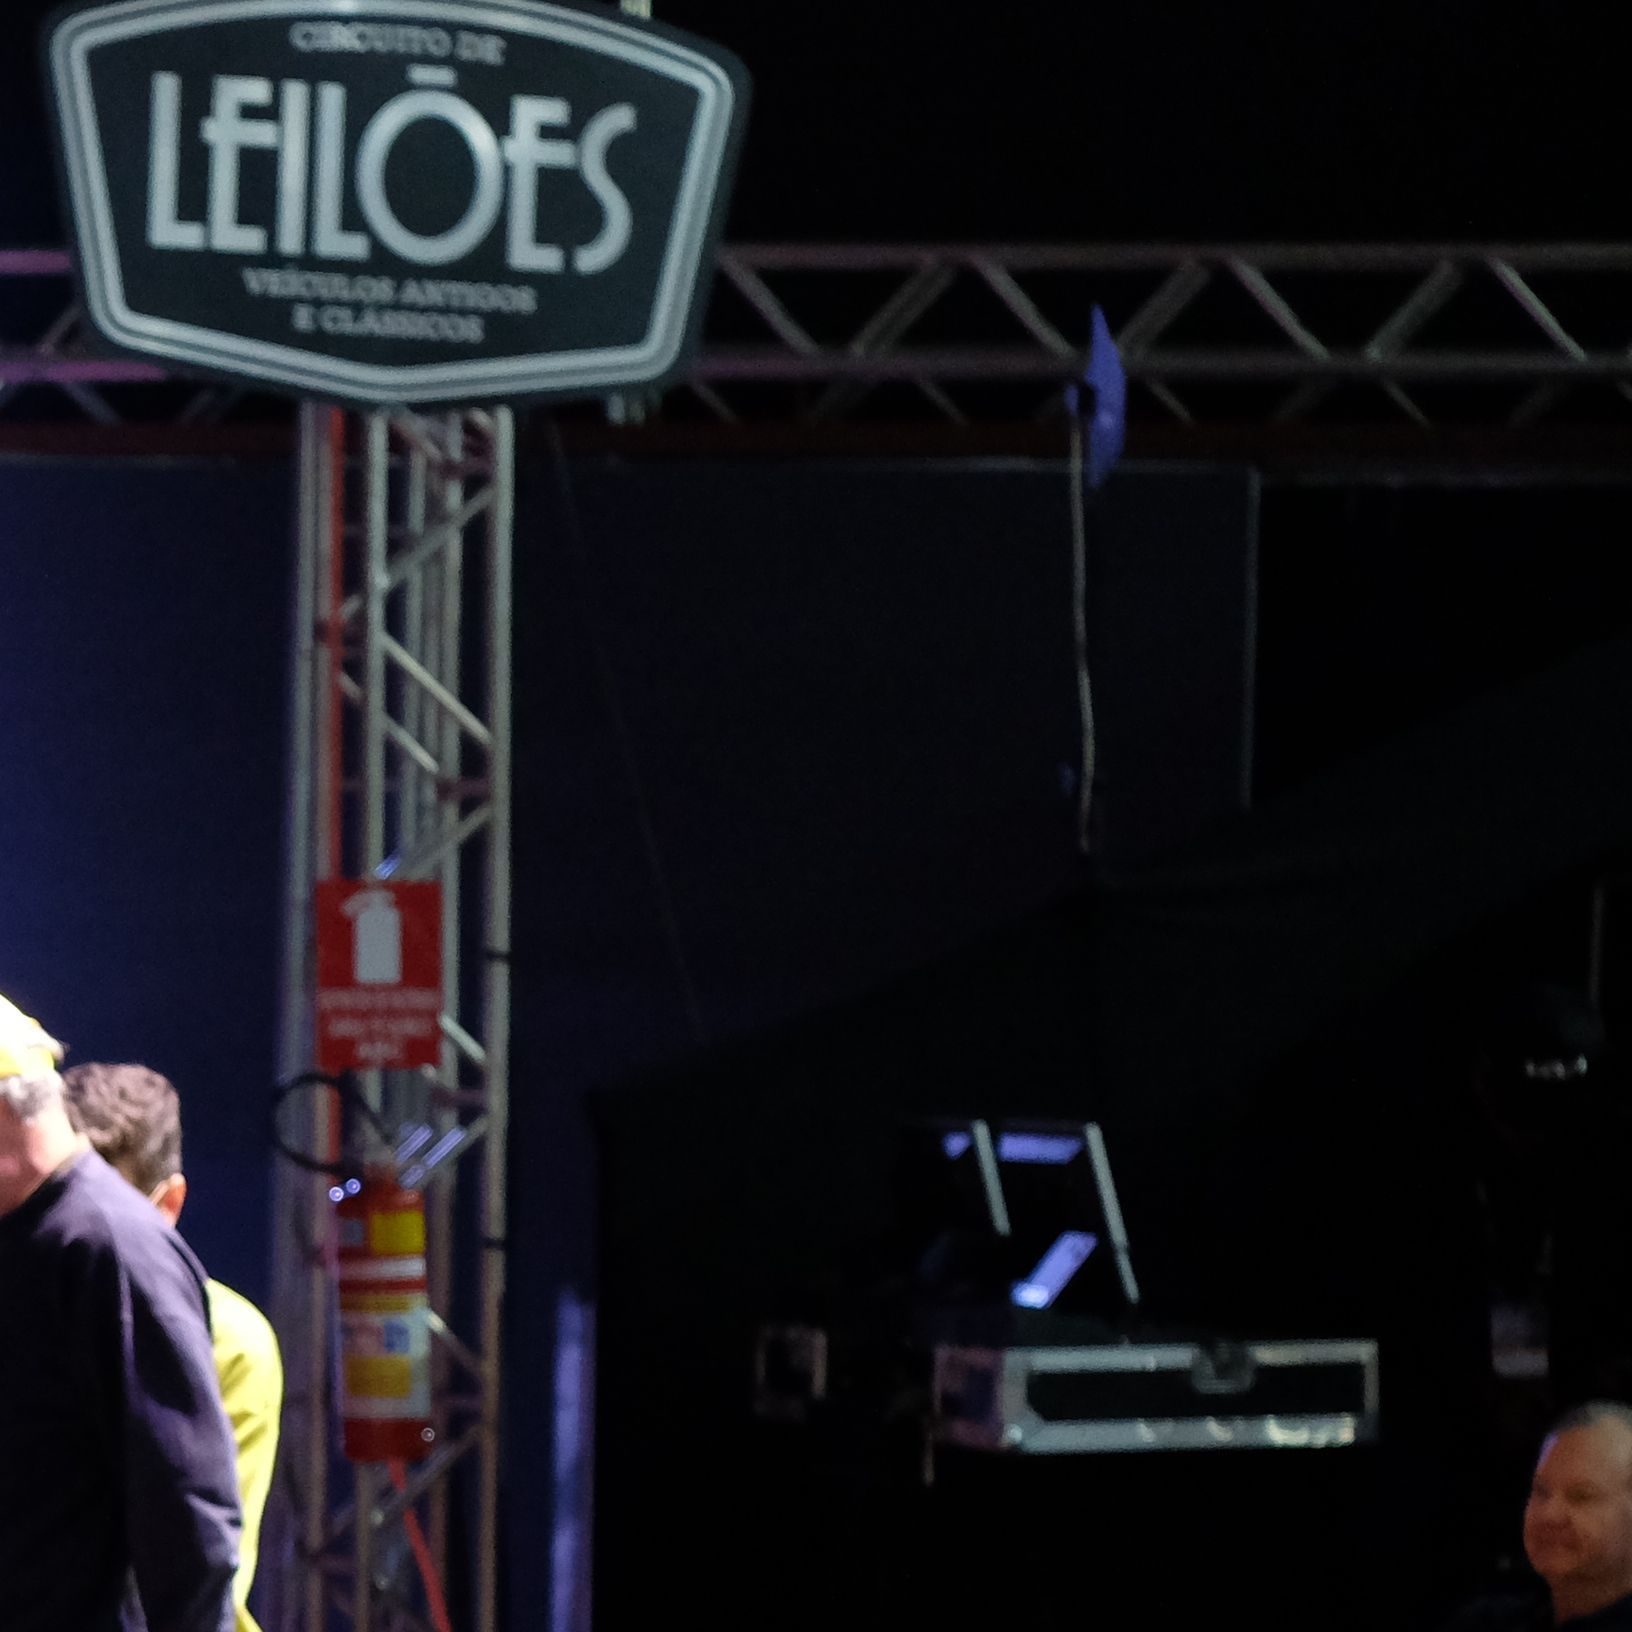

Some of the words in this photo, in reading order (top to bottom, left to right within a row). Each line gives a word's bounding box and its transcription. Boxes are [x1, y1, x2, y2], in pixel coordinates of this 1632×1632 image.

[289, 21, 453, 58] CIRCUITO
[454, 29, 507, 66] DE
[146, 64, 637, 275] LEILÕES
